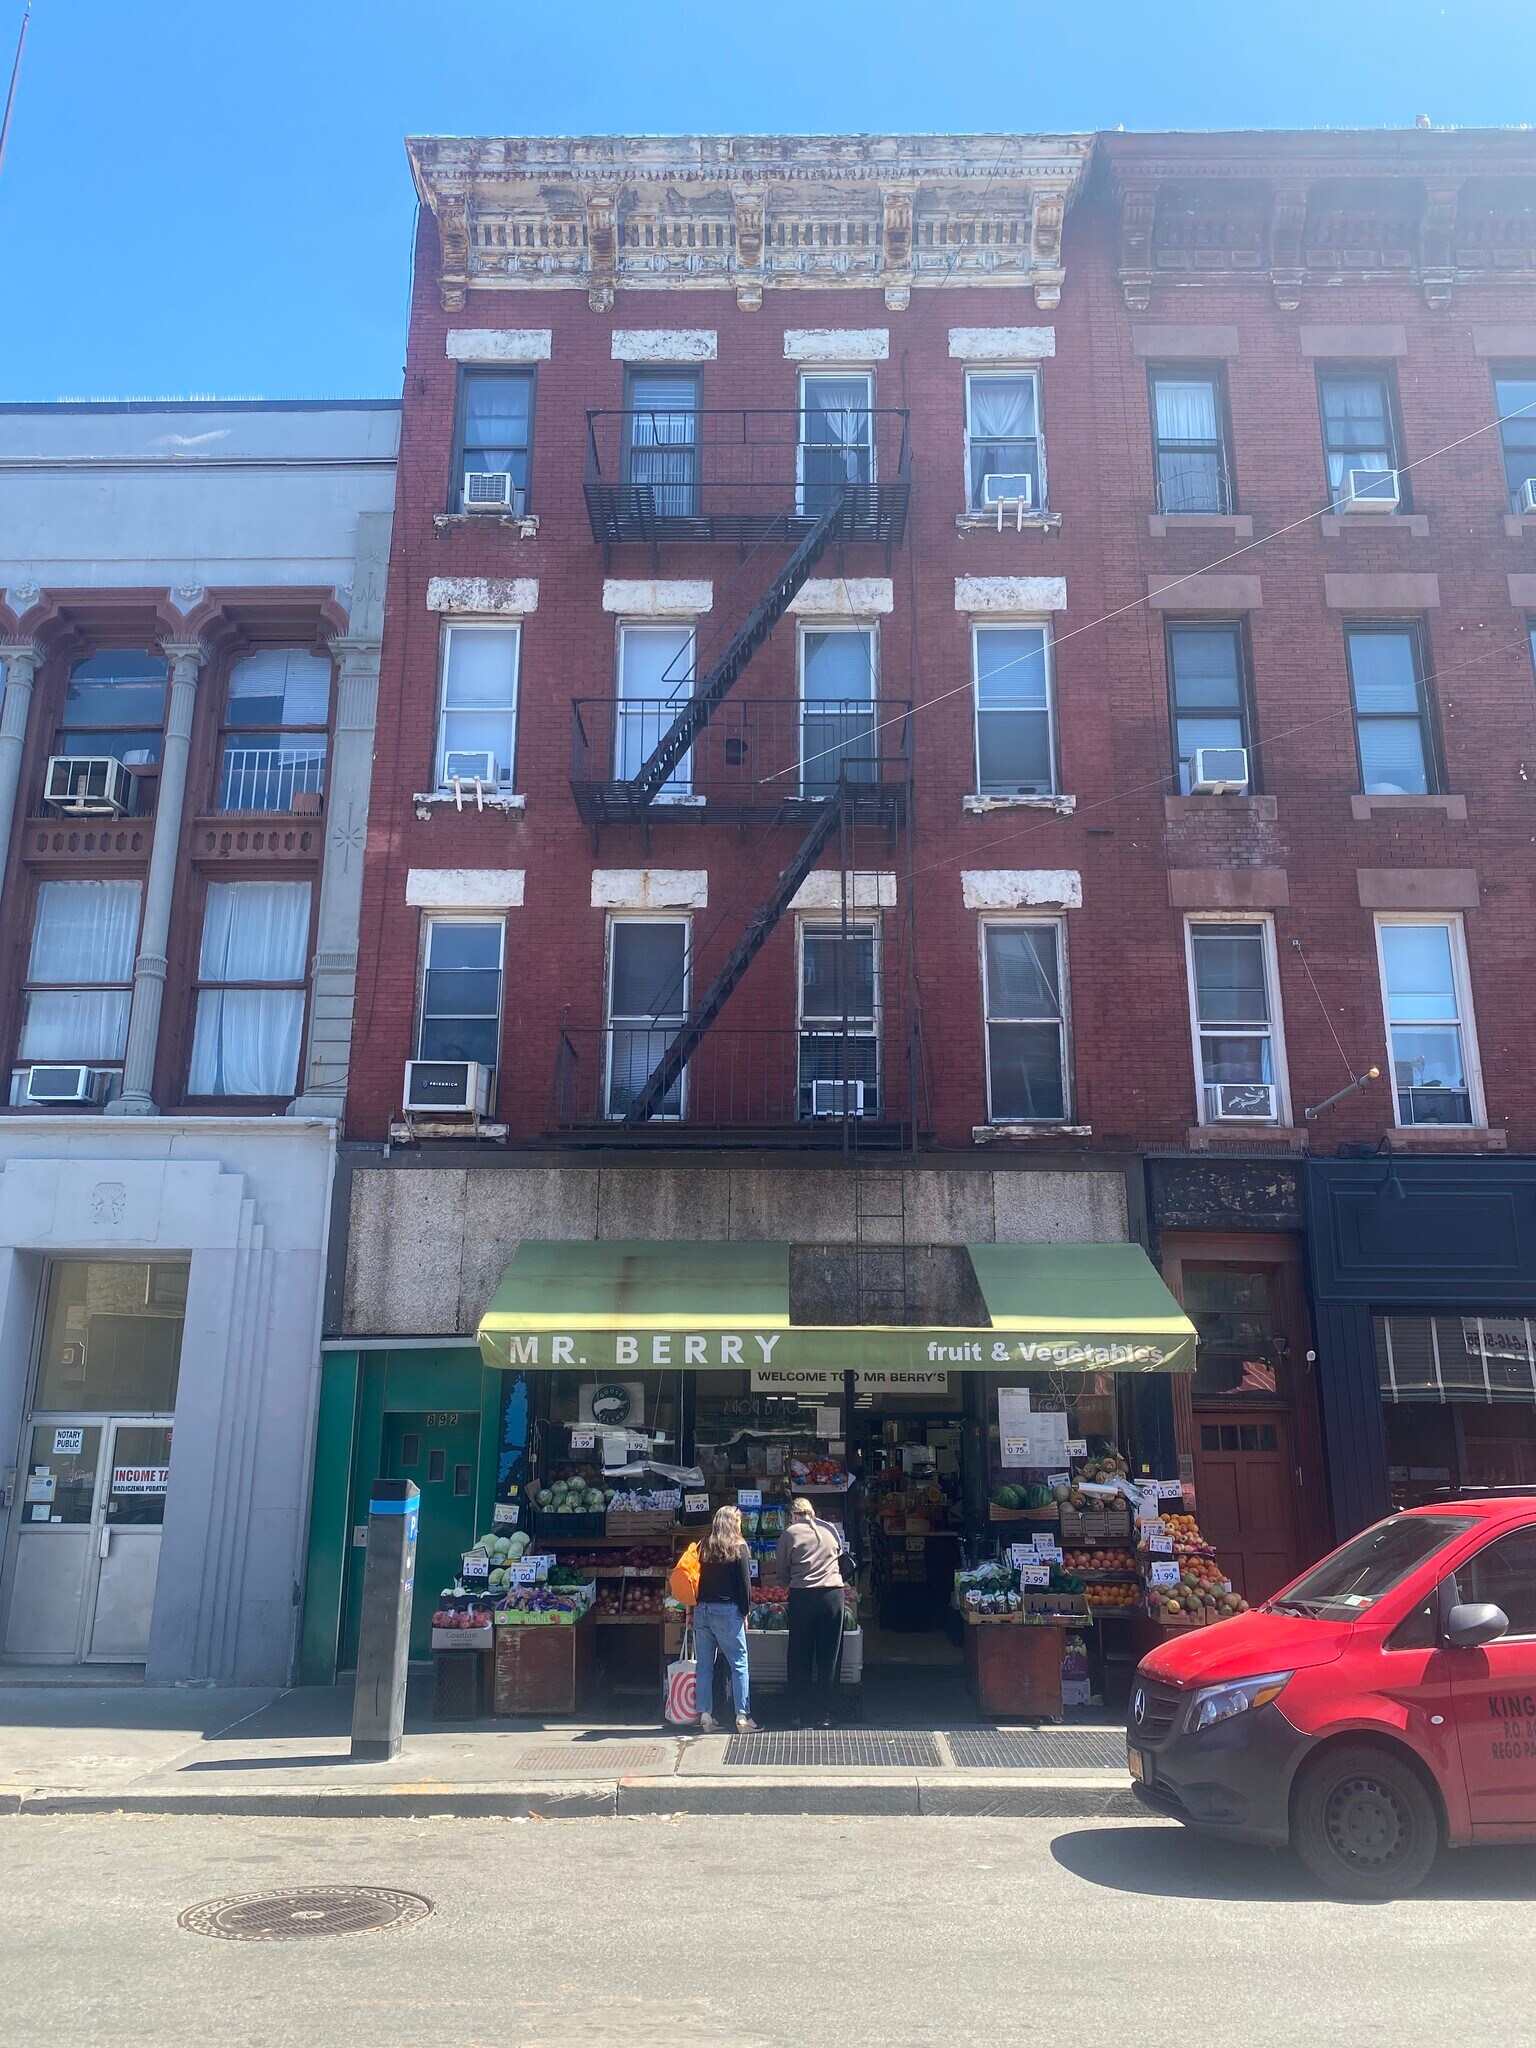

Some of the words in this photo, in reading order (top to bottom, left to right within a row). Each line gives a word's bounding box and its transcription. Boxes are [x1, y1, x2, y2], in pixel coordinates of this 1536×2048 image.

[510, 1336, 587, 1364] MR.
[615, 1335, 780, 1364] BERRY
[927, 1342, 982, 1361] fruit
[991, 1342, 1010, 1361] &
[1018, 1342, 1163, 1366] Vegetables
[757, 1371, 827, 1382] WELCOME
[864, 1372, 886, 1382] MR
[891, 1372, 945, 1383] BERRY'S
[600, 1388, 623, 1398] GOOSE
[427, 1414, 458, 1426] 892
[57, 1430, 82, 1439] NOTARY
[56, 1440, 80, 1448] PUBLIC
[115, 1470, 156, 1482] INCOME
[445, 1631, 478, 1639] Coastline
[1491, 1741, 1522, 1760] REGO
